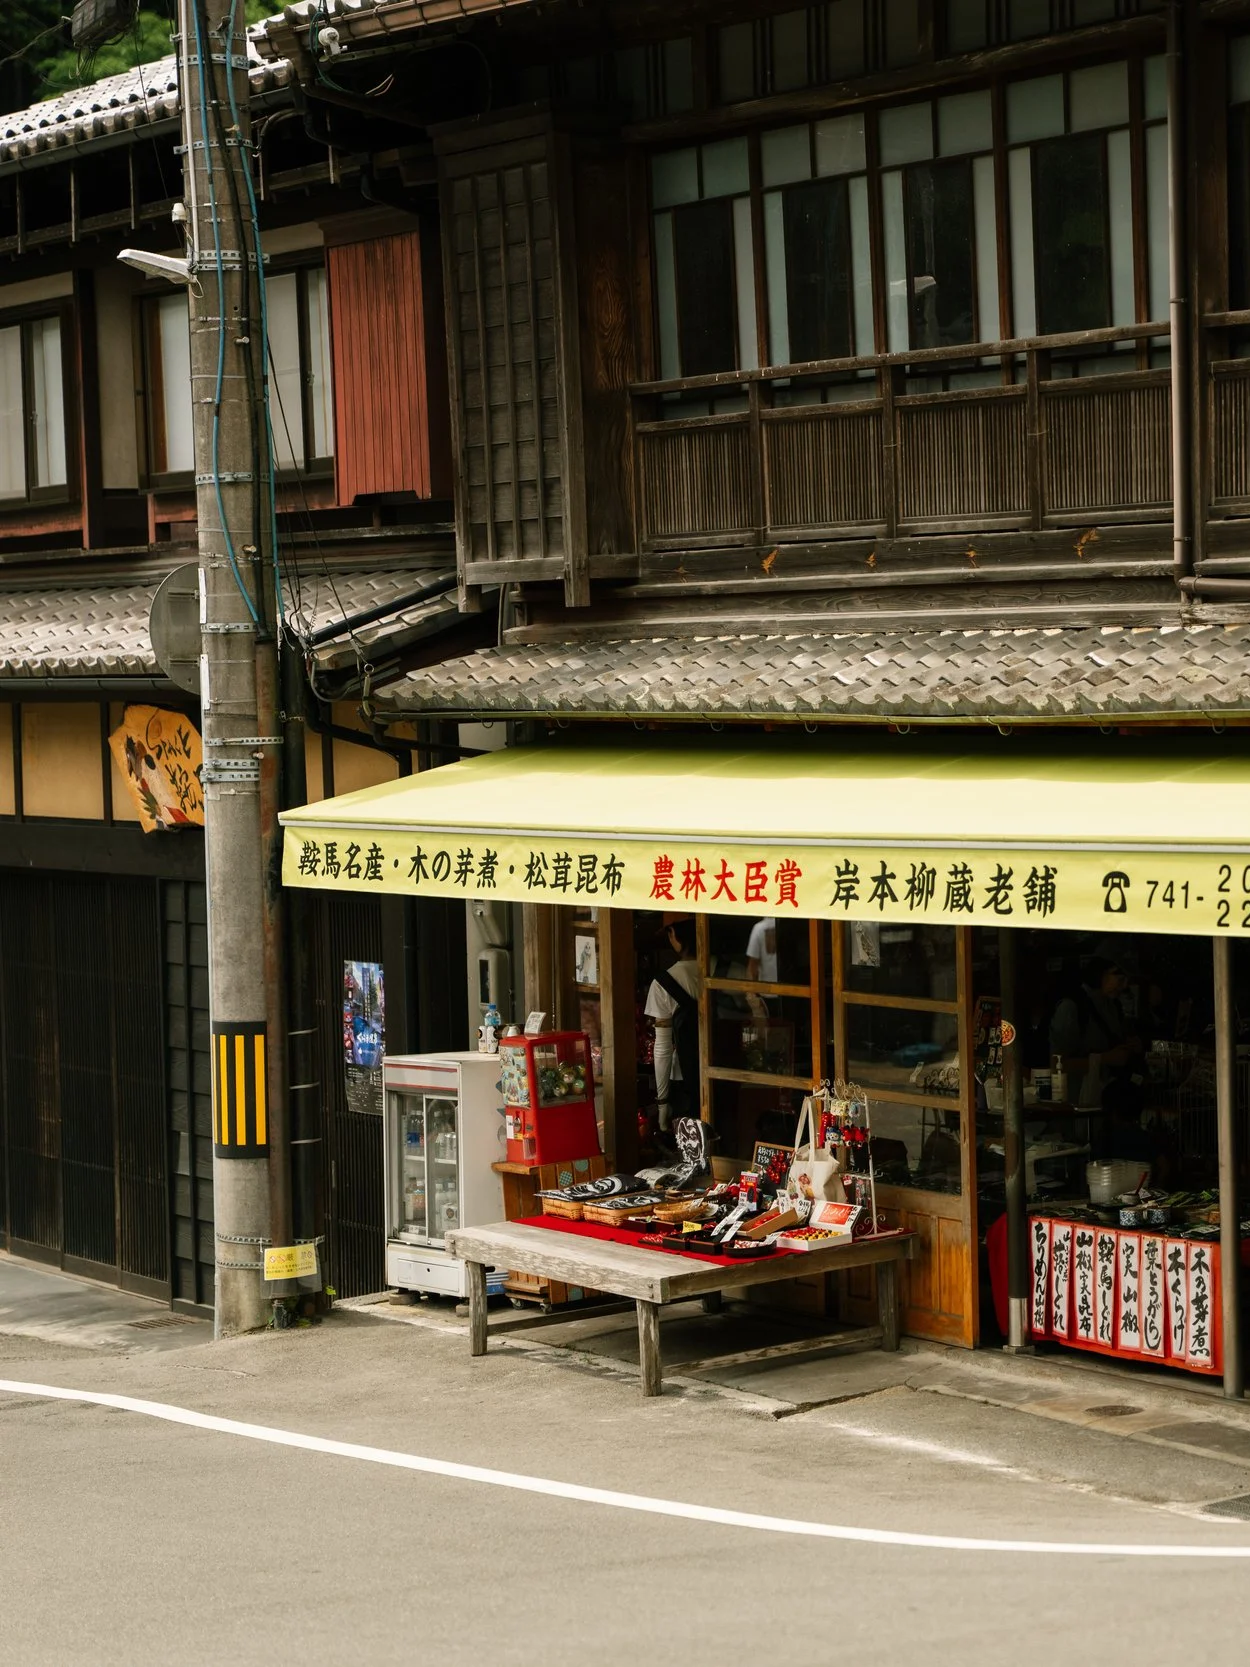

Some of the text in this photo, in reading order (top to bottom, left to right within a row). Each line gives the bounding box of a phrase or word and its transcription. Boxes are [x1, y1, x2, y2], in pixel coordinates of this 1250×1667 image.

[648, 854, 803, 908] 農林大臣賞
[829, 858, 1058, 919] 岸本柳蔵老舗
[1146, 880, 1204, 909] 741-
[1121, 1242, 1140, 1334] 実山椒
[1144, 1241, 1162, 1350] 葉とうがらし
